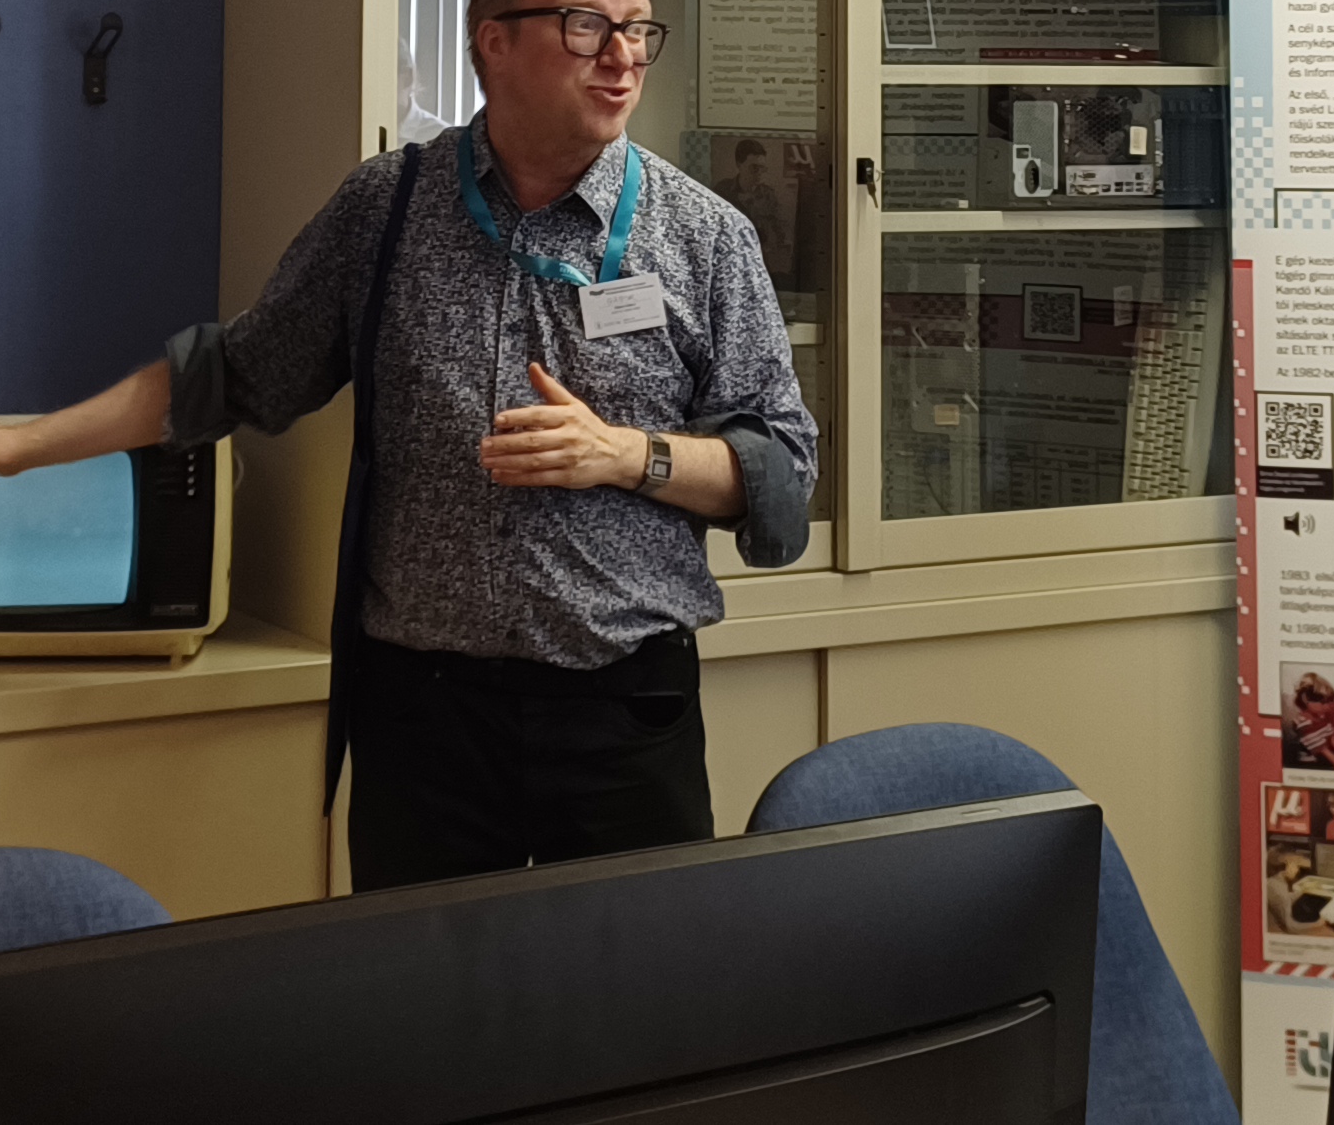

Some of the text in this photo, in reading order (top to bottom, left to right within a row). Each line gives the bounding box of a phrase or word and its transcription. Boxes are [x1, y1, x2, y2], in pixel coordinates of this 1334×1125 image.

[1298, 23, 1313, 33] cél
[1288, 68, 1301, 77] és
[1288, 90, 1300, 99] Az
